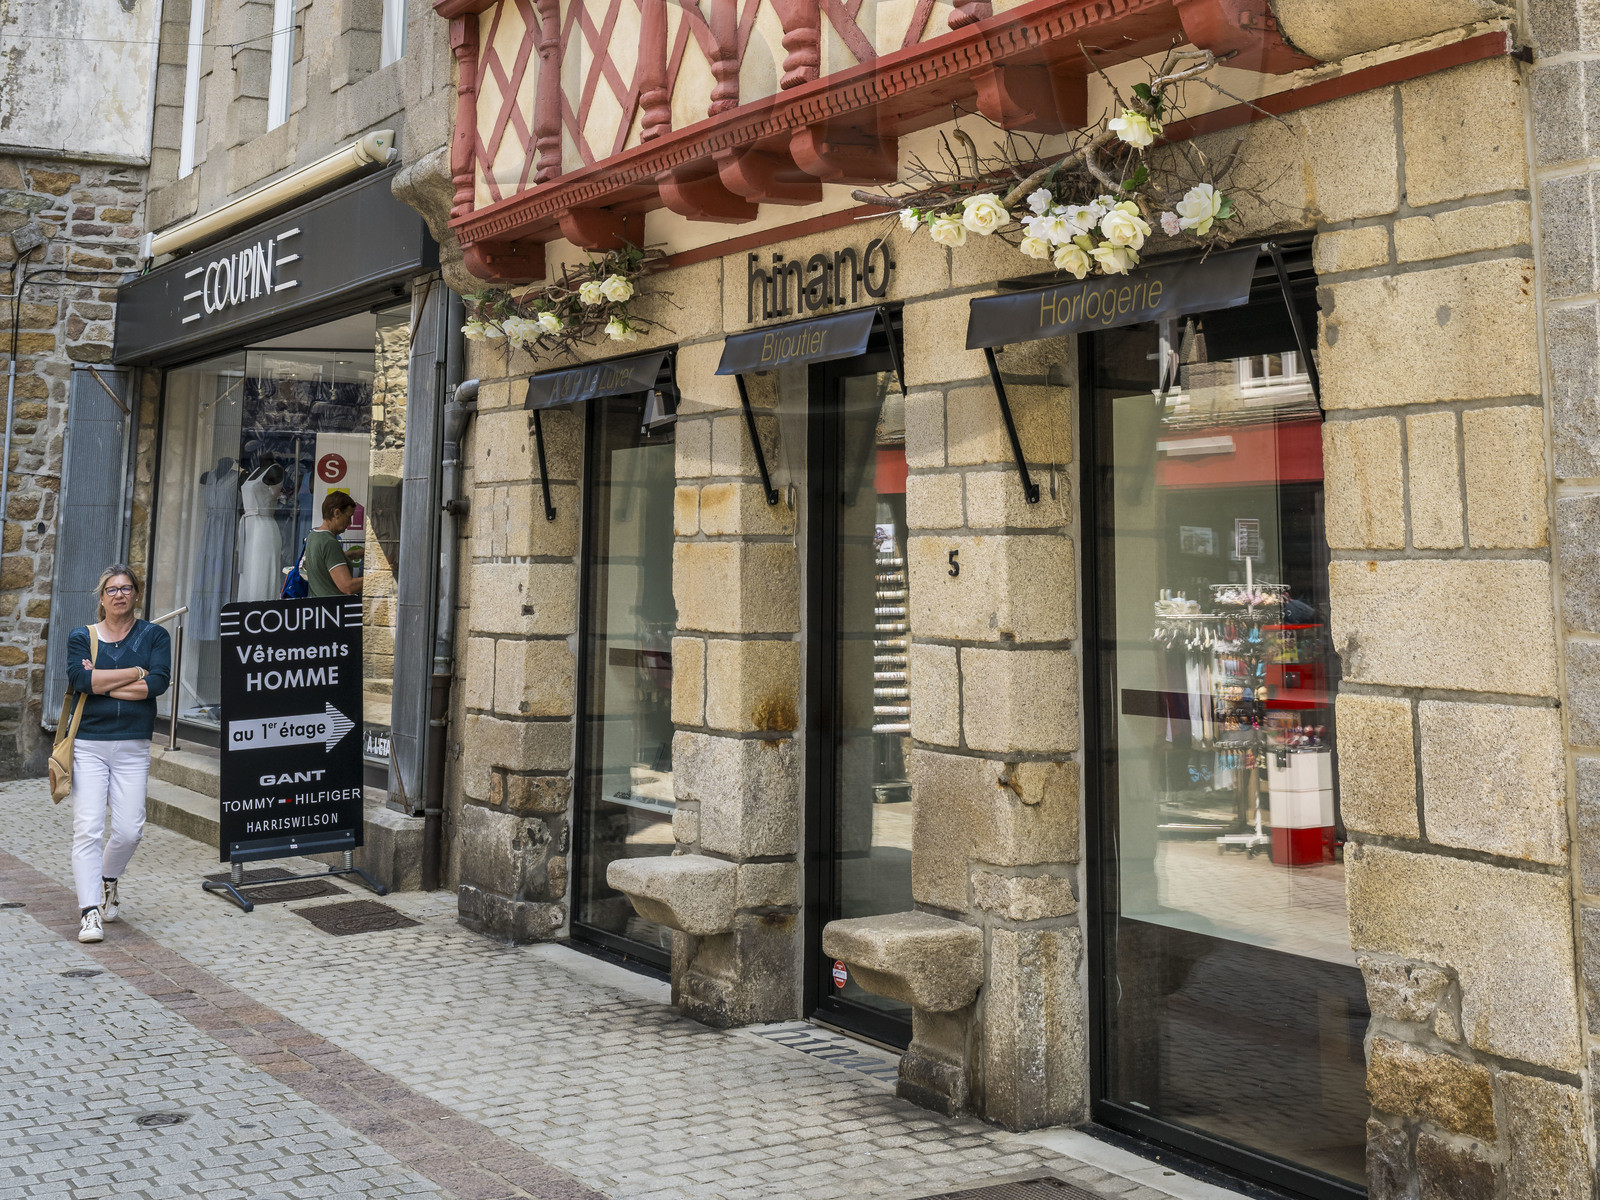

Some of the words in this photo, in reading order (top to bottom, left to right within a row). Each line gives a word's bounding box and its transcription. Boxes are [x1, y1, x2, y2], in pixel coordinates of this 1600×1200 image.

[203, 239, 274, 314] COUPIN
[748, 238, 890, 323] hinano
[1040, 273, 1163, 327] Horlogerie
[761, 326, 827, 365] Bijoutier
[948, 549, 960, 577] 5
[244, 605, 340, 634] COUPIN
[236, 641, 349, 664] Vêtements
[246, 666, 339, 692] HOMME
[233, 729, 254, 742] au
[261, 721, 277, 740] 1er
[279, 720, 327, 739] étage
[259, 769, 326, 787] GANT
[222, 796, 275, 813] TOMMY
[295, 788, 361, 805] HILFIGER
[246, 812, 339, 833] HARRISWILSON
[750, 1025, 900, 1087] hinan
